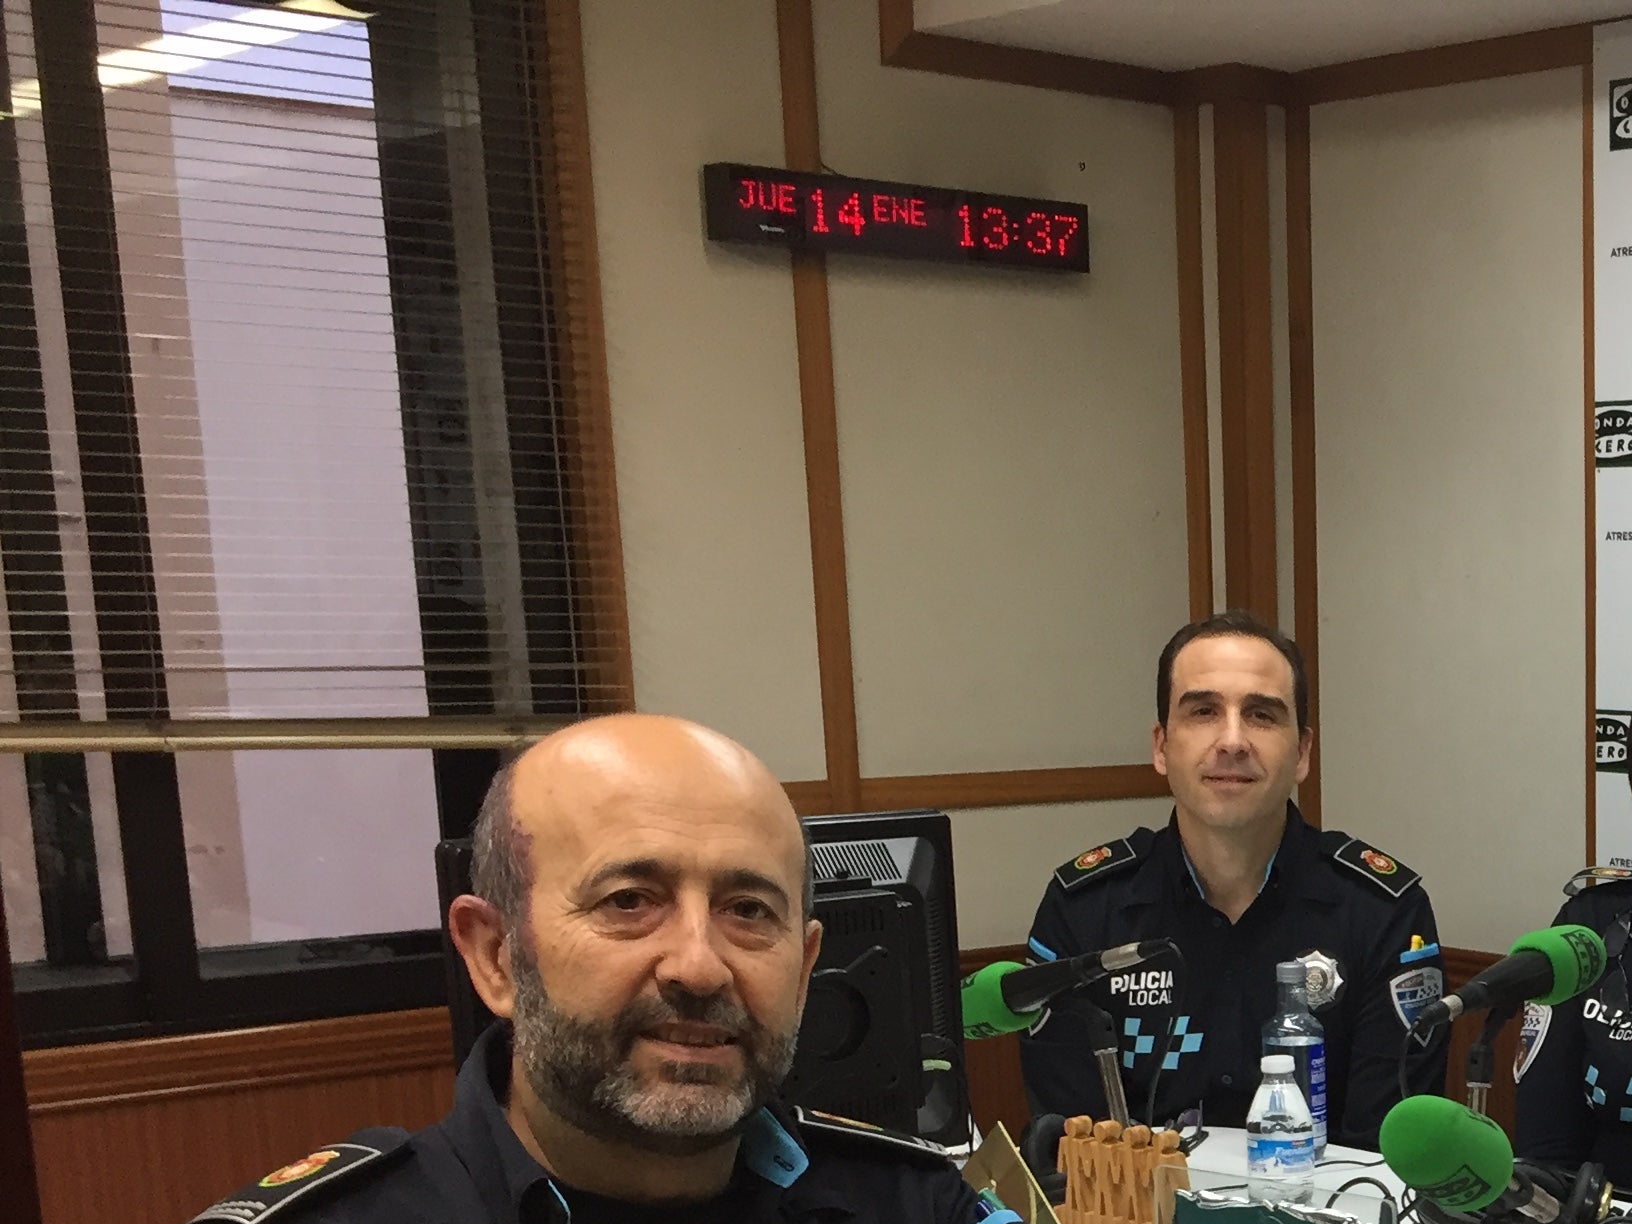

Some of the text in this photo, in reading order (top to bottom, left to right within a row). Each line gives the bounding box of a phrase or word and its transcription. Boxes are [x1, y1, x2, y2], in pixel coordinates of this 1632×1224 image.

[738, 179, 1079, 256] JUE 14 ENE 13:37
